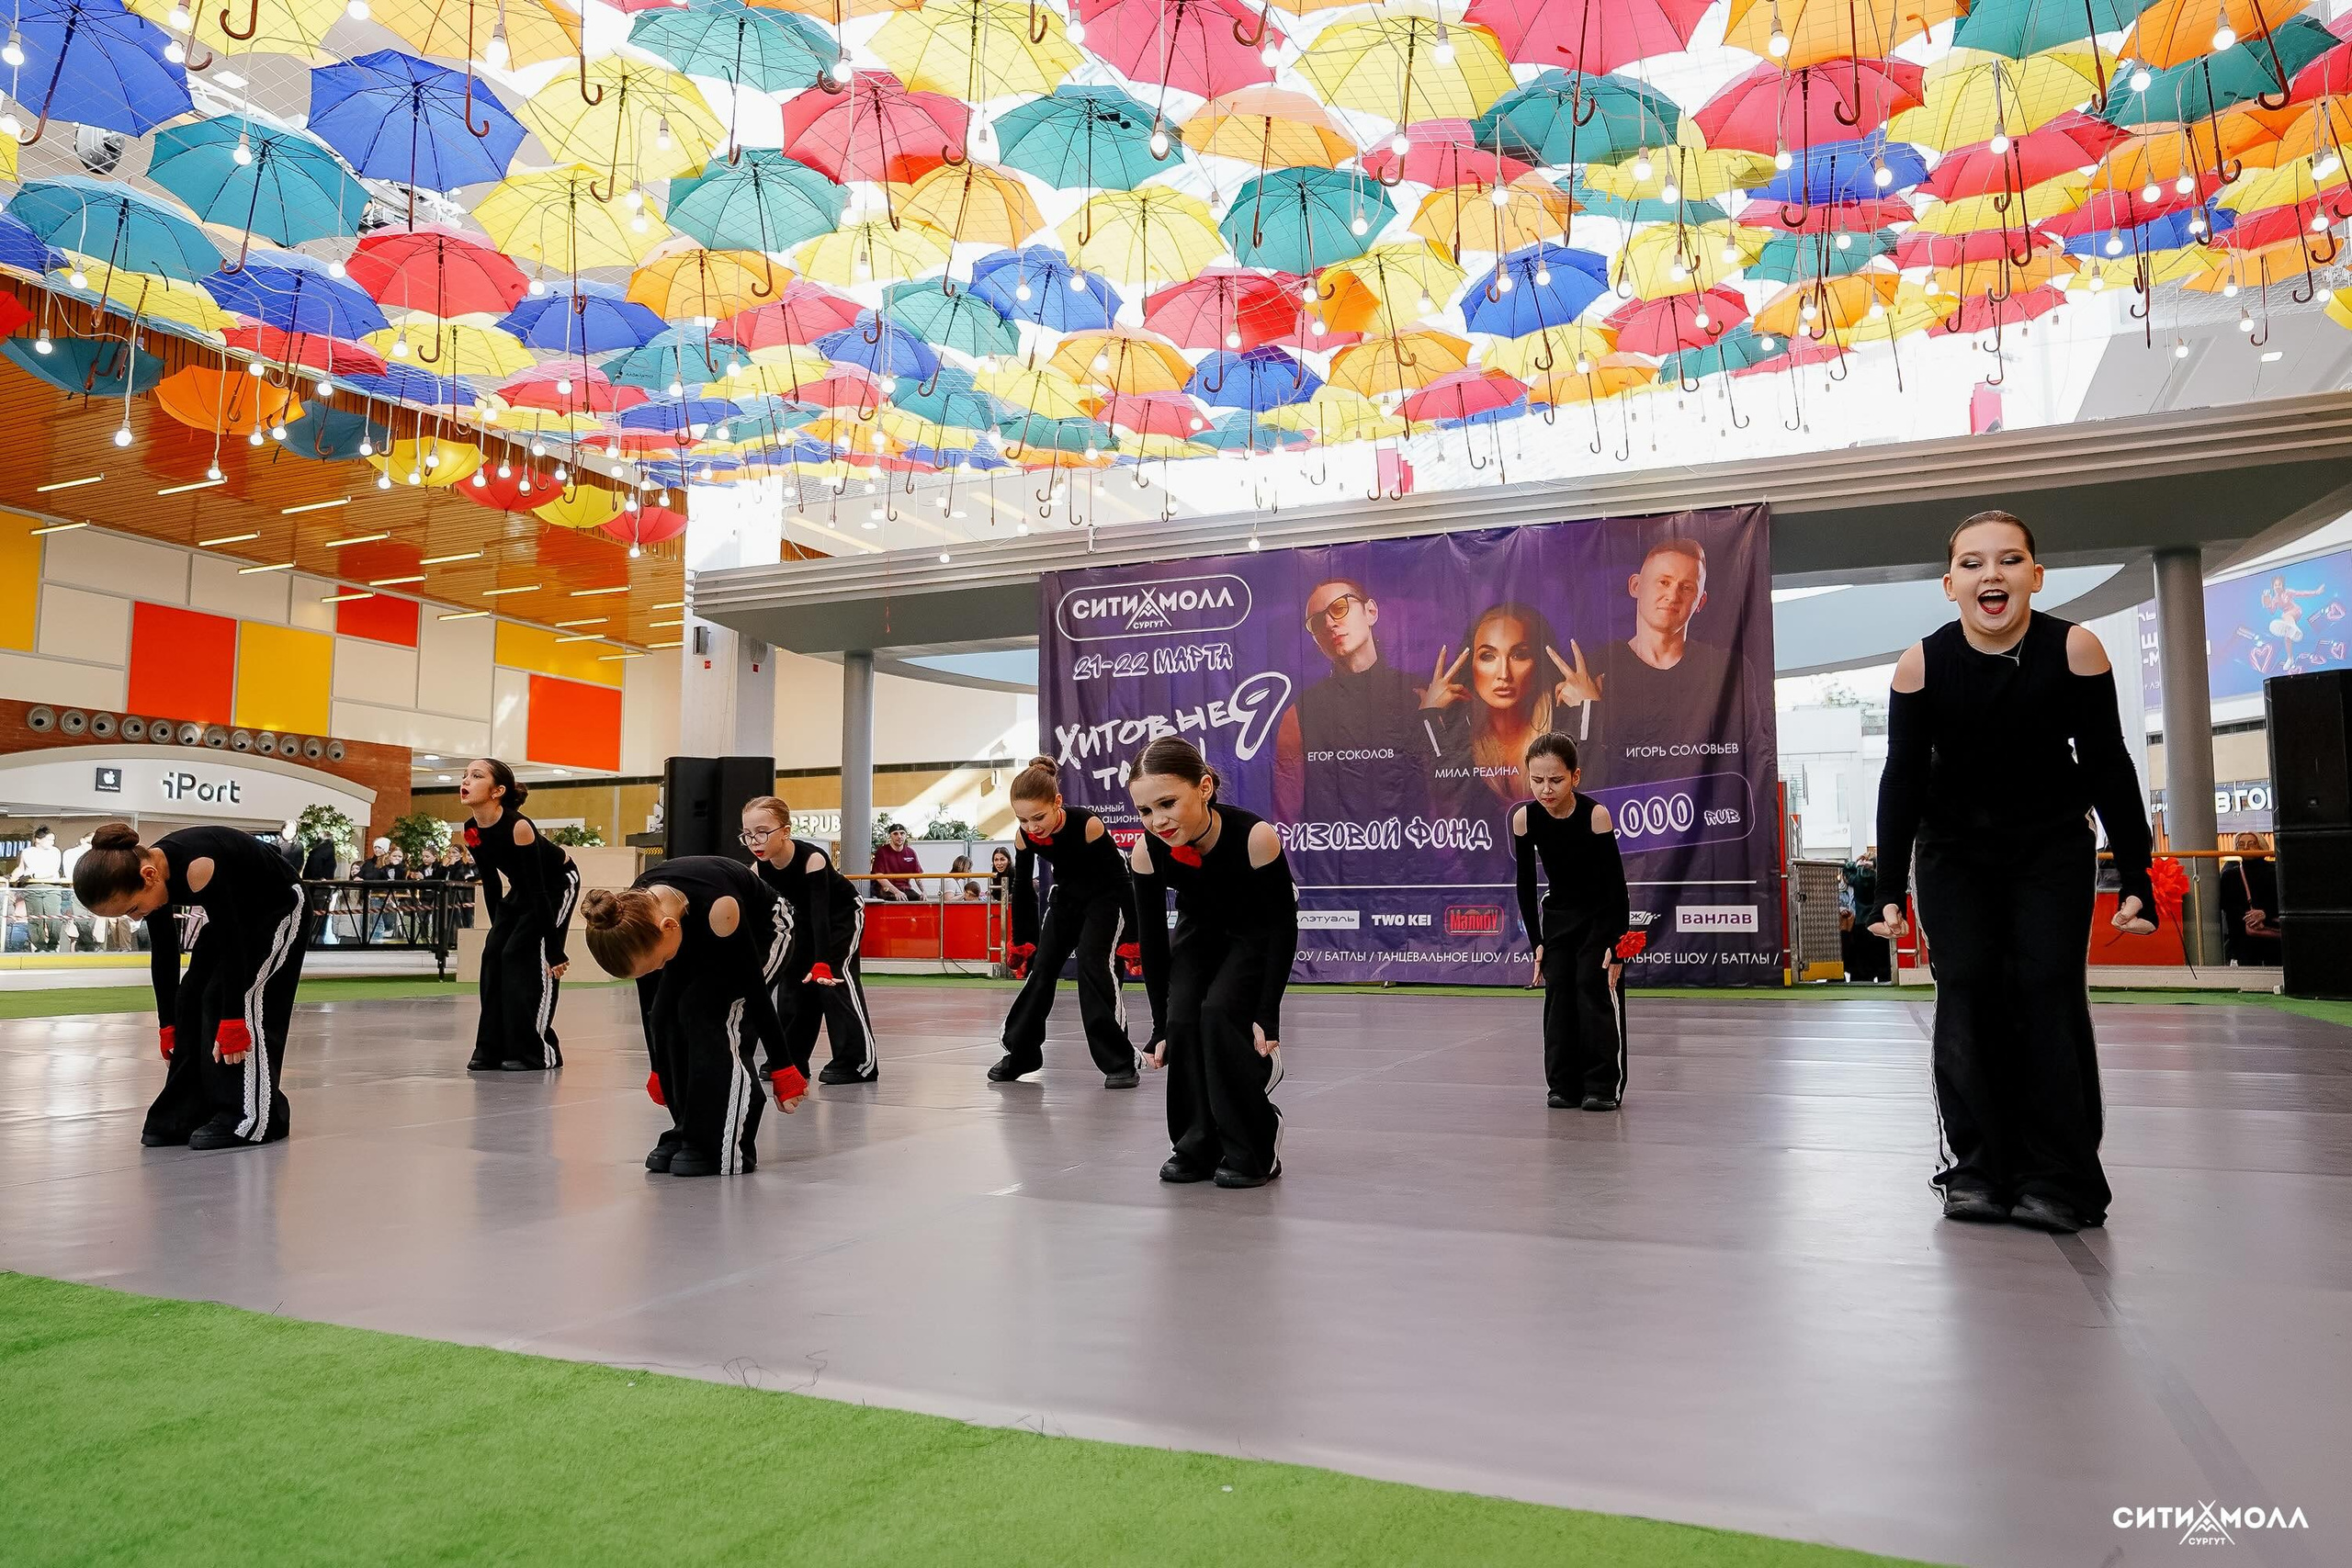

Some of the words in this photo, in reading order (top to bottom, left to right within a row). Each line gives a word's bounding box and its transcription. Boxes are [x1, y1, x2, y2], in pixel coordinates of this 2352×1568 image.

[1072, 595, 1138, 619] СИТИ
[1159, 587, 1235, 612] МОЛЛ
[1133, 620, 1165, 630] СУРГУТ
[1073, 652, 1148, 681] 21-22
[1153, 643, 1233, 675] МАРТА
[1307, 751, 1334, 761] ЕГОР
[1336, 749, 1395, 761] СОКОЛОВ
[1626, 746, 1667, 758] ИГОРЬ
[1669, 742, 1739, 757] СОЛОВЬЕВ
[1435, 769, 1470, 779] МИЛА
[1473, 766, 1520, 777] РЕДИНА
[163, 772, 241, 803] iPort
[1102, 815, 1142, 824] ационн
[1613, 793, 1694, 840] .000
[1704, 808, 1741, 826] RUB
[790, 815, 842, 834] REPUB
[1113, 832, 1140, 843] СУРГ
[1273, 817, 1401, 852] РИЗОВОЙ
[1372, 914, 1405, 927] TWO
[1408, 914, 1431, 927] KEI
[1682, 914, 1752, 924] ванлав
[1325, 951, 1366, 962] БАТТЛЫ
[1378, 952, 1468, 963] ТАНЦЕВАЛЬНОЕ
[1471, 953, 1502, 963] ШОУ
[1514, 953, 1533, 963] БАТ
[1675, 953, 1708, 964] ШОУ
[1722, 953, 1770, 964] БАТТЛЫ
